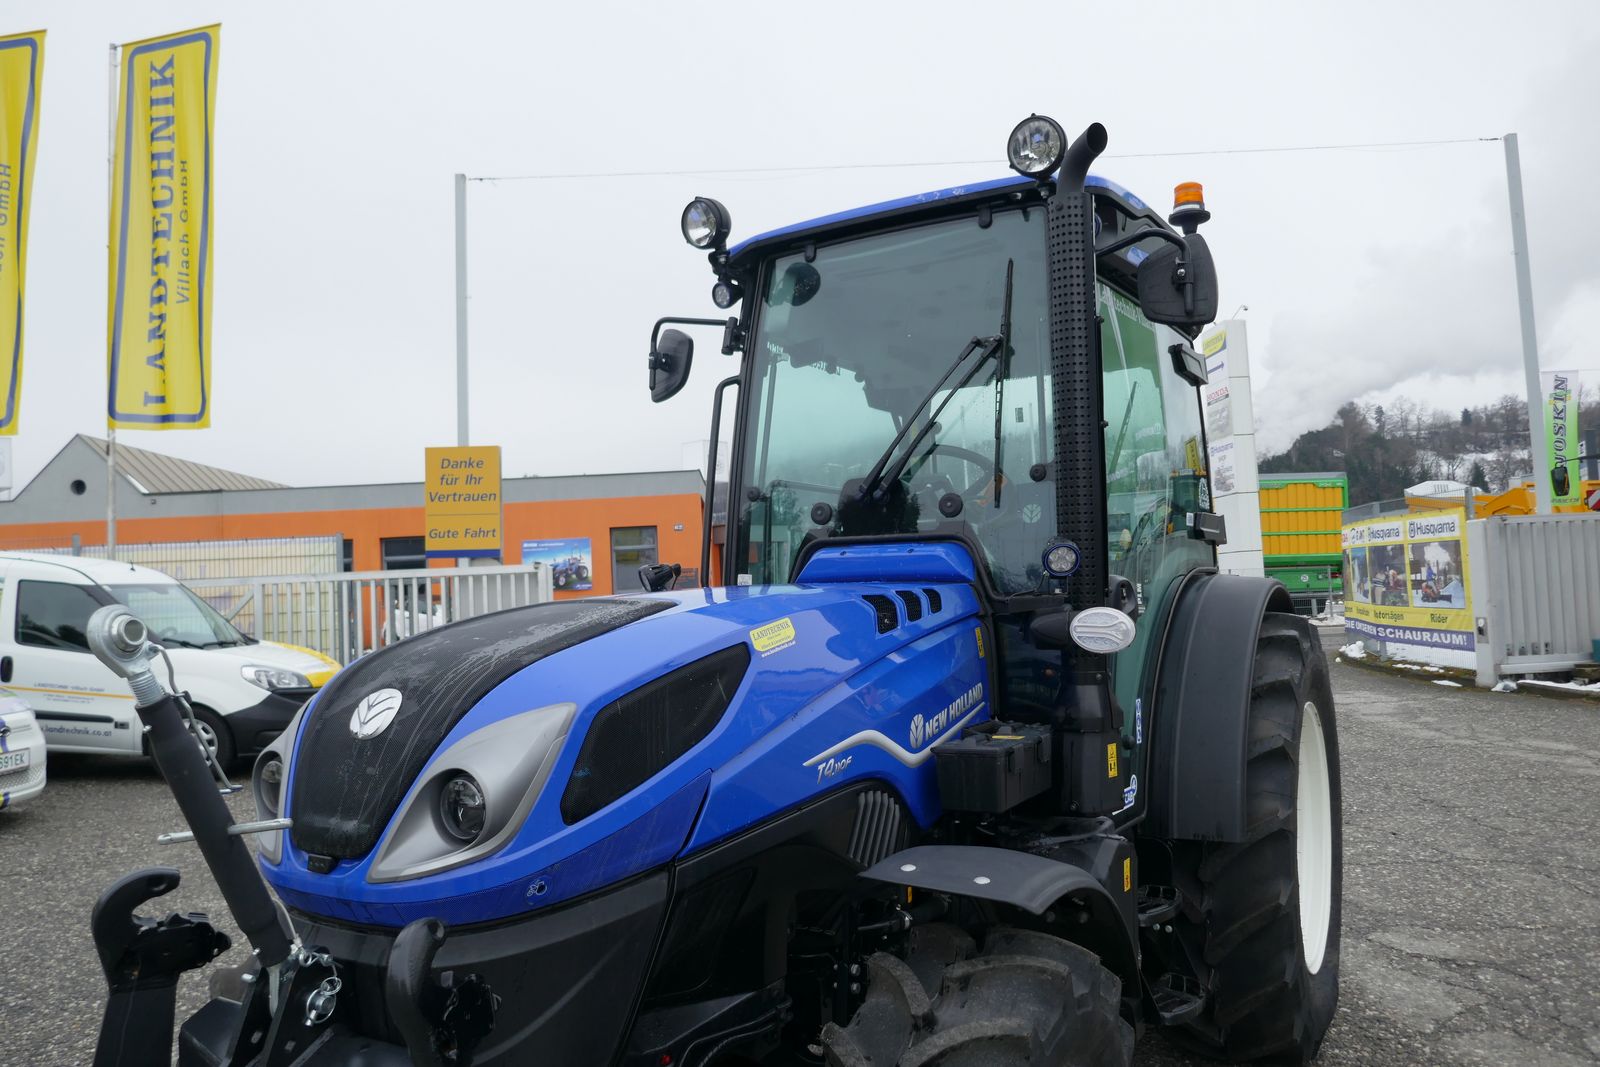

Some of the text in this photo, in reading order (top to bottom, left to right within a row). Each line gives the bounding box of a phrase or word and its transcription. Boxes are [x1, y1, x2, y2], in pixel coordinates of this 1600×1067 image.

[143, 54, 175, 407] LANDTECHNIK
[176, 160, 190, 304] Villach GmbH
[440, 457, 485, 470] Danke
[439, 474, 484, 486] für Ihr
[429, 491, 497, 503] Vertrauen
[428, 527, 497, 539] Gute Fahrt
[1370, 527, 1400, 540] Husqvarna
[1415, 521, 1456, 537] Husqvarna
[1430, 613, 1449, 624] Rider
[1377, 627, 1468, 645] SCHAURAUM!
[925, 682, 983, 741] NEW HOLLAND
